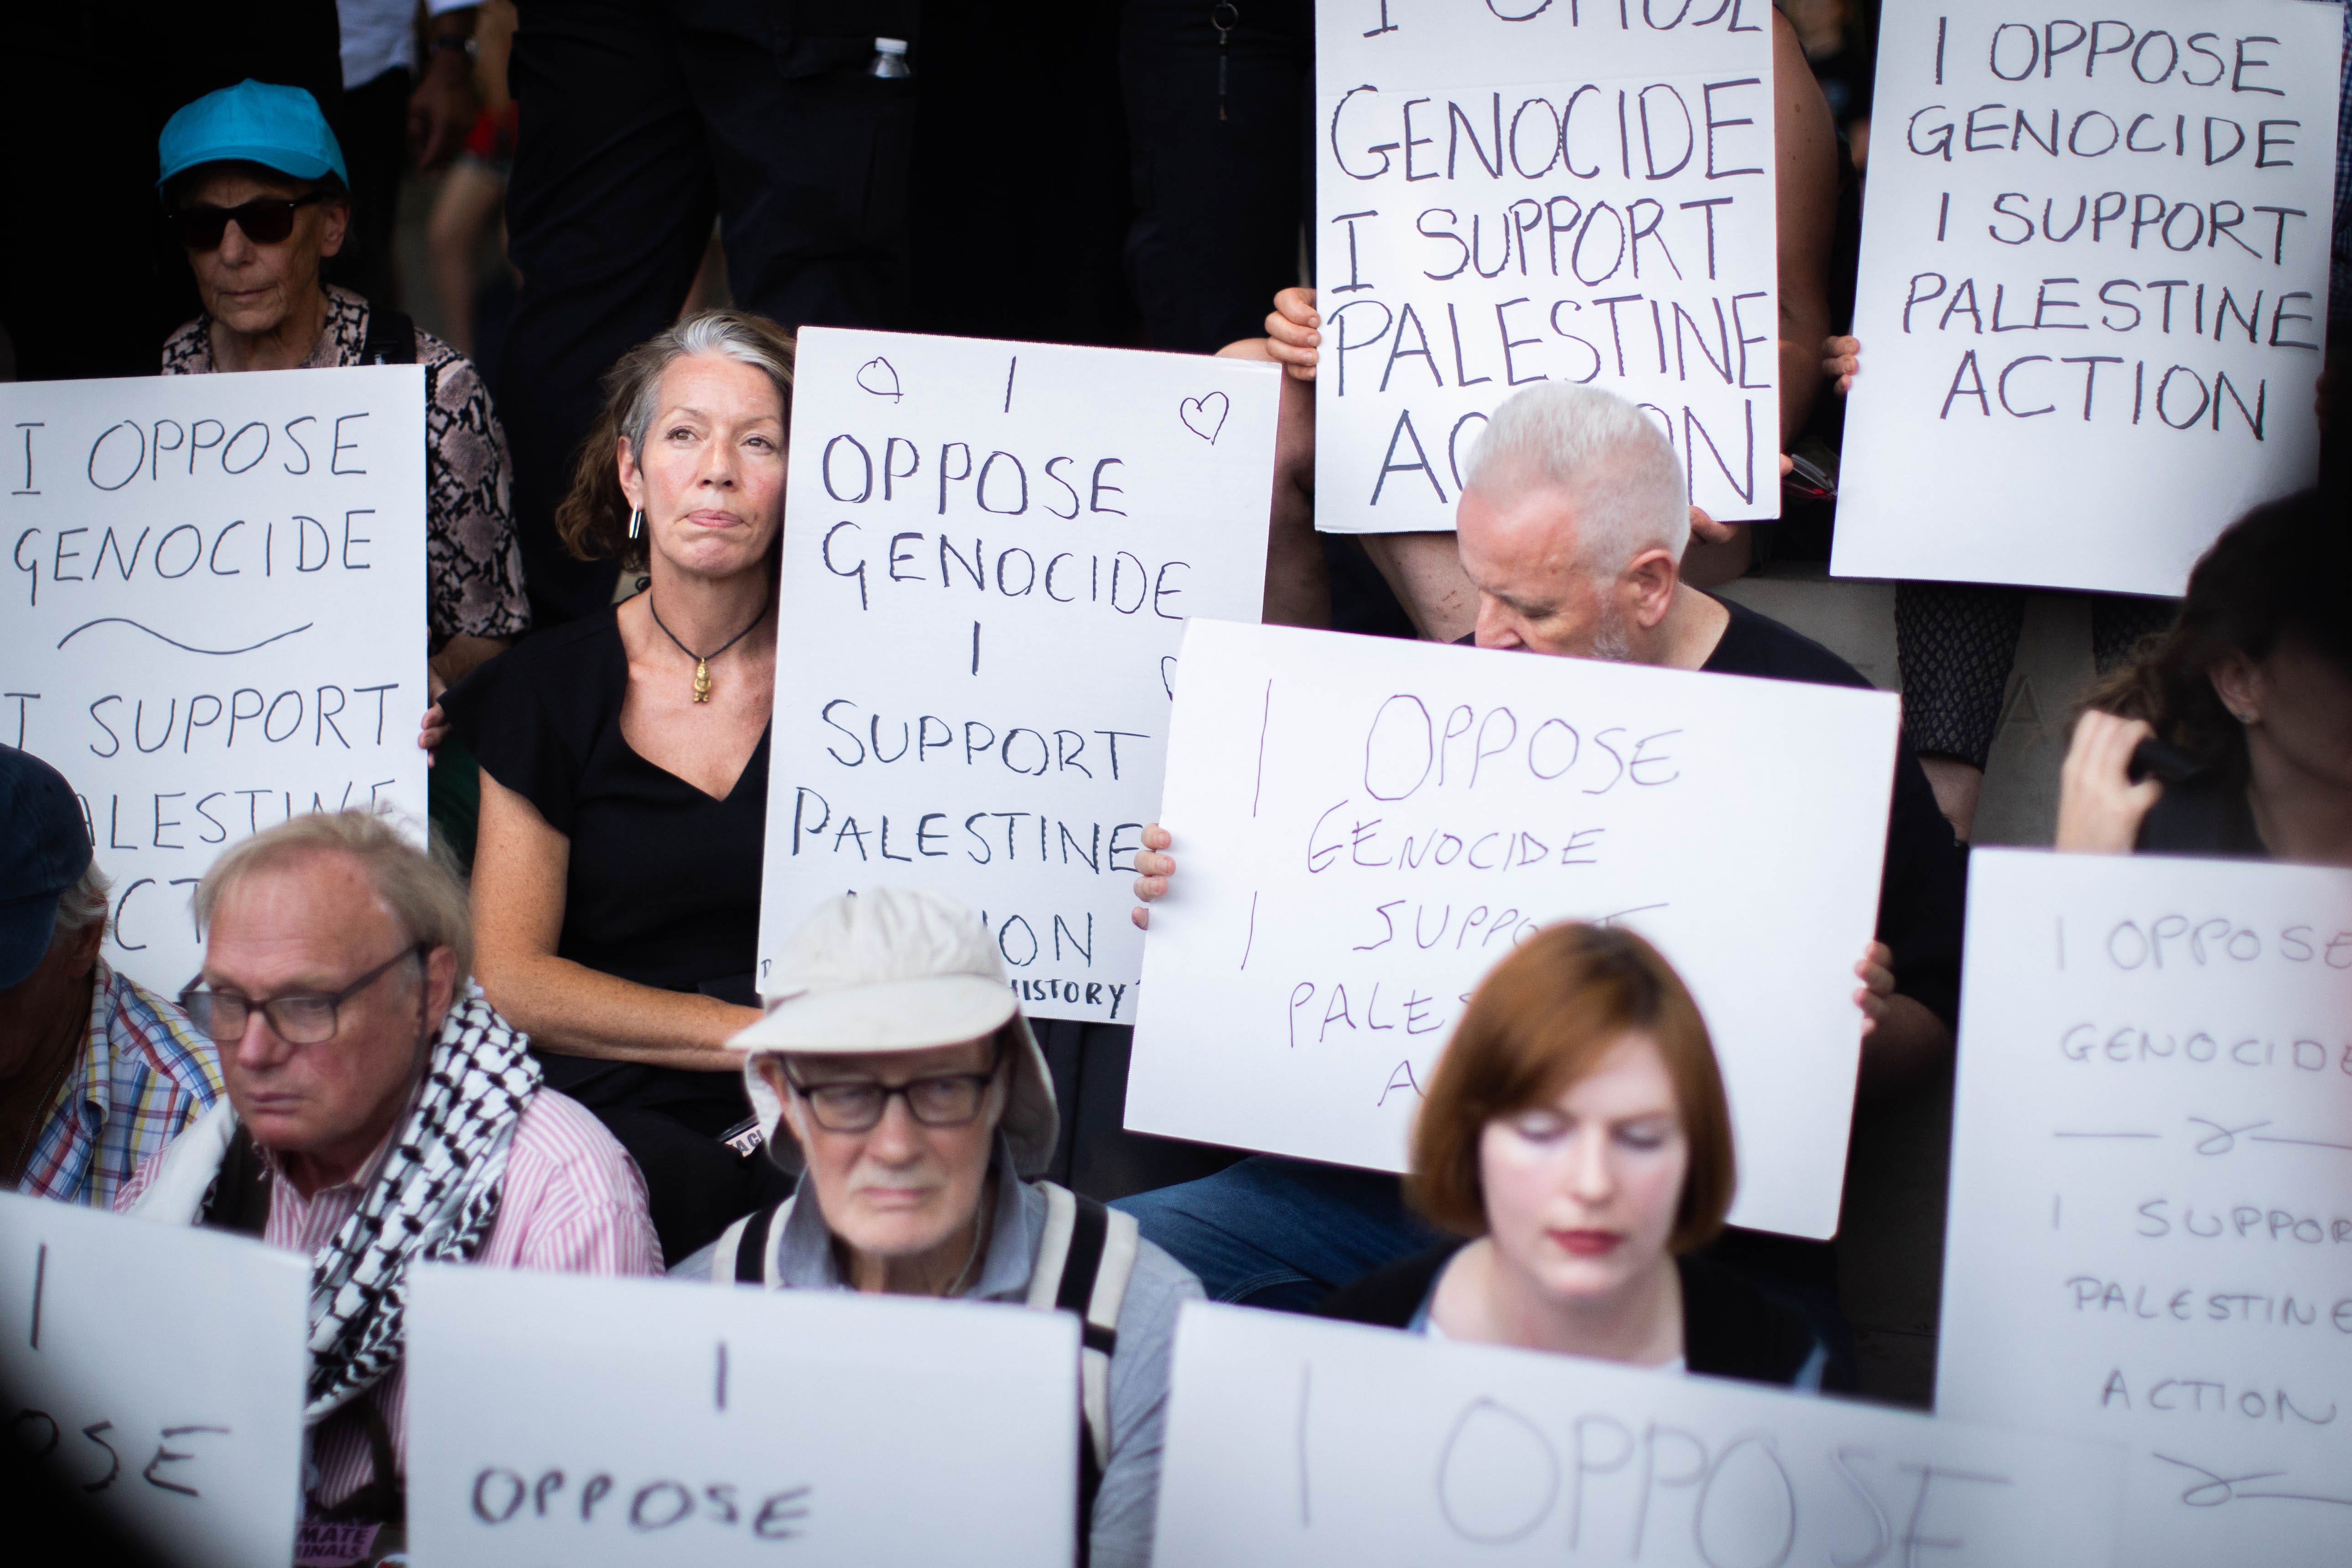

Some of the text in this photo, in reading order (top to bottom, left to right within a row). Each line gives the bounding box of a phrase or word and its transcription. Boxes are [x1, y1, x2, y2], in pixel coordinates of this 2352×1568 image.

[1935, 16, 2285, 96] I OPPOSE
[1331, 78, 1765, 182] GENOCIDE
[1907, 104, 2301, 168] GENOCIDE
[1331, 195, 1734, 293] I SUPPORT
[1937, 192, 2307, 265] I SUPPORT
[1327, 291, 1772, 397] PALESTINE
[1903, 272, 2319, 351] PALESTINE
[1004, 356, 1017, 413] I
[1940, 349, 2265, 442] ACTION
[11, 412, 370, 495] I OPPOSE
[823, 434, 1127, 520] OPPOSE
[14, 509, 376, 607] GENOCIDE
[823, 521, 1191, 620] GENOCIDE
[971, 620, 981, 677] I
[89, 683, 400, 758] SUPPORT
[822, 699, 1151, 780] SUPPORT
[1253, 678, 1684, 818] I OPPOSE
[792, 787, 1142, 875] PALESTINE
[1307, 799, 1605, 873] GENOCIDE
[1241, 891, 1257, 971] I
[2055, 915, 2352, 972] I OPPOSE
[2052, 1194, 2061, 1231] I
[30, 1242, 47, 1350] I
[2064, 1277, 2352, 1334] PALESTINE
[717, 1340, 727, 1413] I
[2102, 1369, 2337, 1425] ACTION
[471, 1466, 812, 1541] OPPOSE
[1299, 1361, 2015, 1568] I OPPOSE
